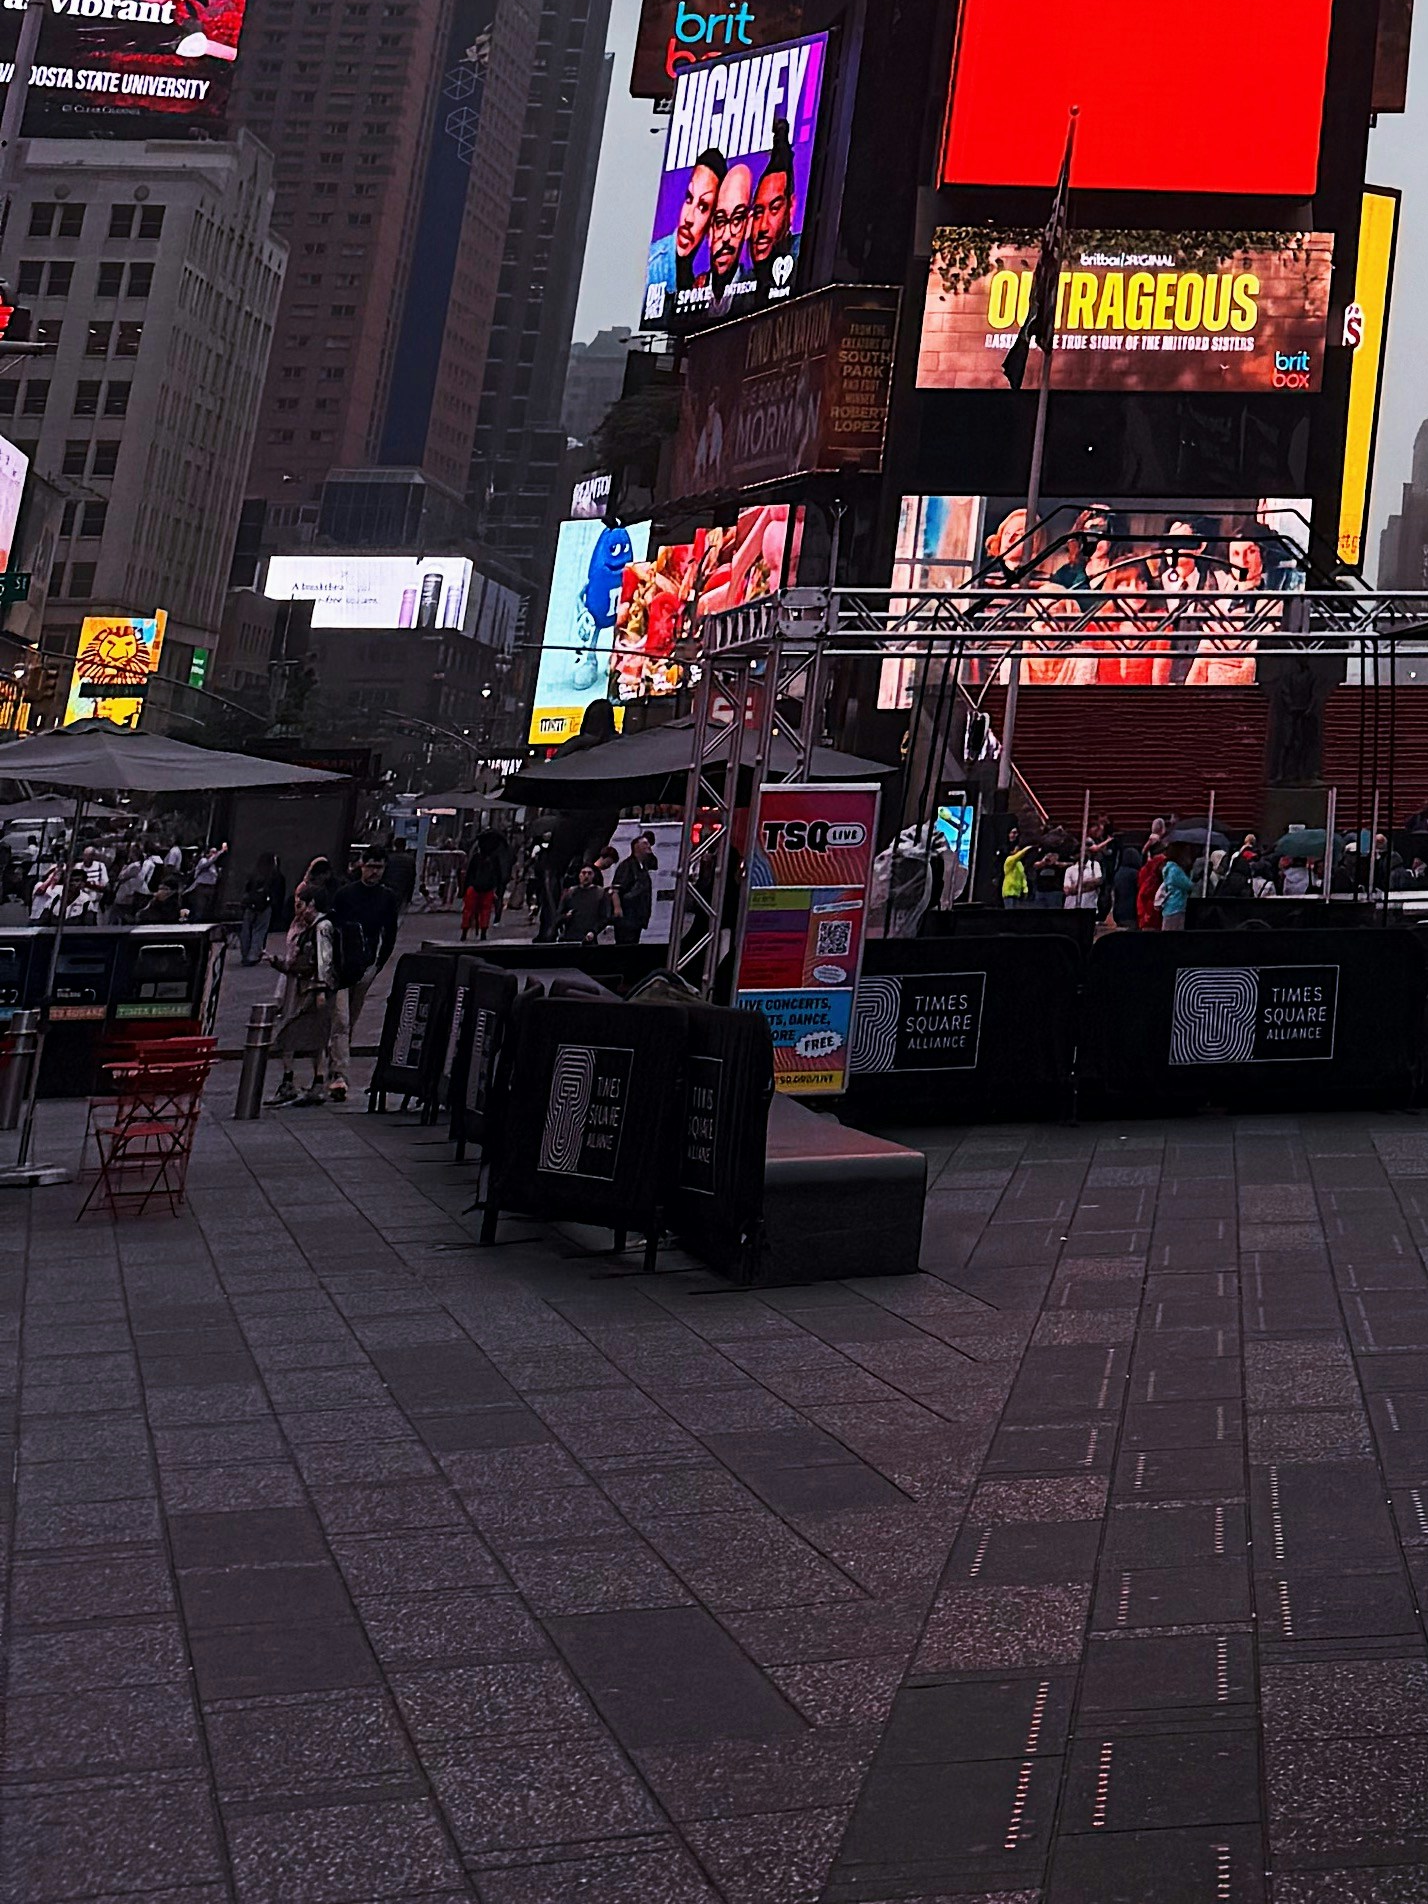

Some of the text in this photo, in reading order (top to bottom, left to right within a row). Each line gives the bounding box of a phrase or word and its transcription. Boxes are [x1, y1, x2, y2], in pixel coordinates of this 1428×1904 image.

[675, 1, 755, 46] brit
[75, 69, 210, 100] STATE UNIVERSITY
[1062, 336, 1087, 350] TRUE
[1089, 336, 1123, 351] STORY
[1126, 337, 1140, 350] OF
[1141, 337, 1160, 350] THE
[838, 351, 892, 363] SOUTH
[1275, 351, 1310, 372] brit
[843, 365, 884, 377] PARK
[1273, 371, 1311, 389] box
[830, 406, 886, 419] ROBERT
[834, 421, 880, 433] LOPEZ
[762, 820, 857, 854] TSQ LIVE
[1272, 985, 1323, 1004] TIMES
[739, 997, 832, 1011] LIVE CONCERTS,
[914, 993, 969, 1013] TIMES
[788, 1013, 831, 1026] DANCE,
[1263, 1004, 1328, 1025] SQUARE
[905, 1014, 974, 1034] SQUARE
[907, 1034, 967, 1050] ALLIANCE
[1266, 1026, 1323, 1042] ALLIANCE
[804, 1036, 835, 1052] FREE
